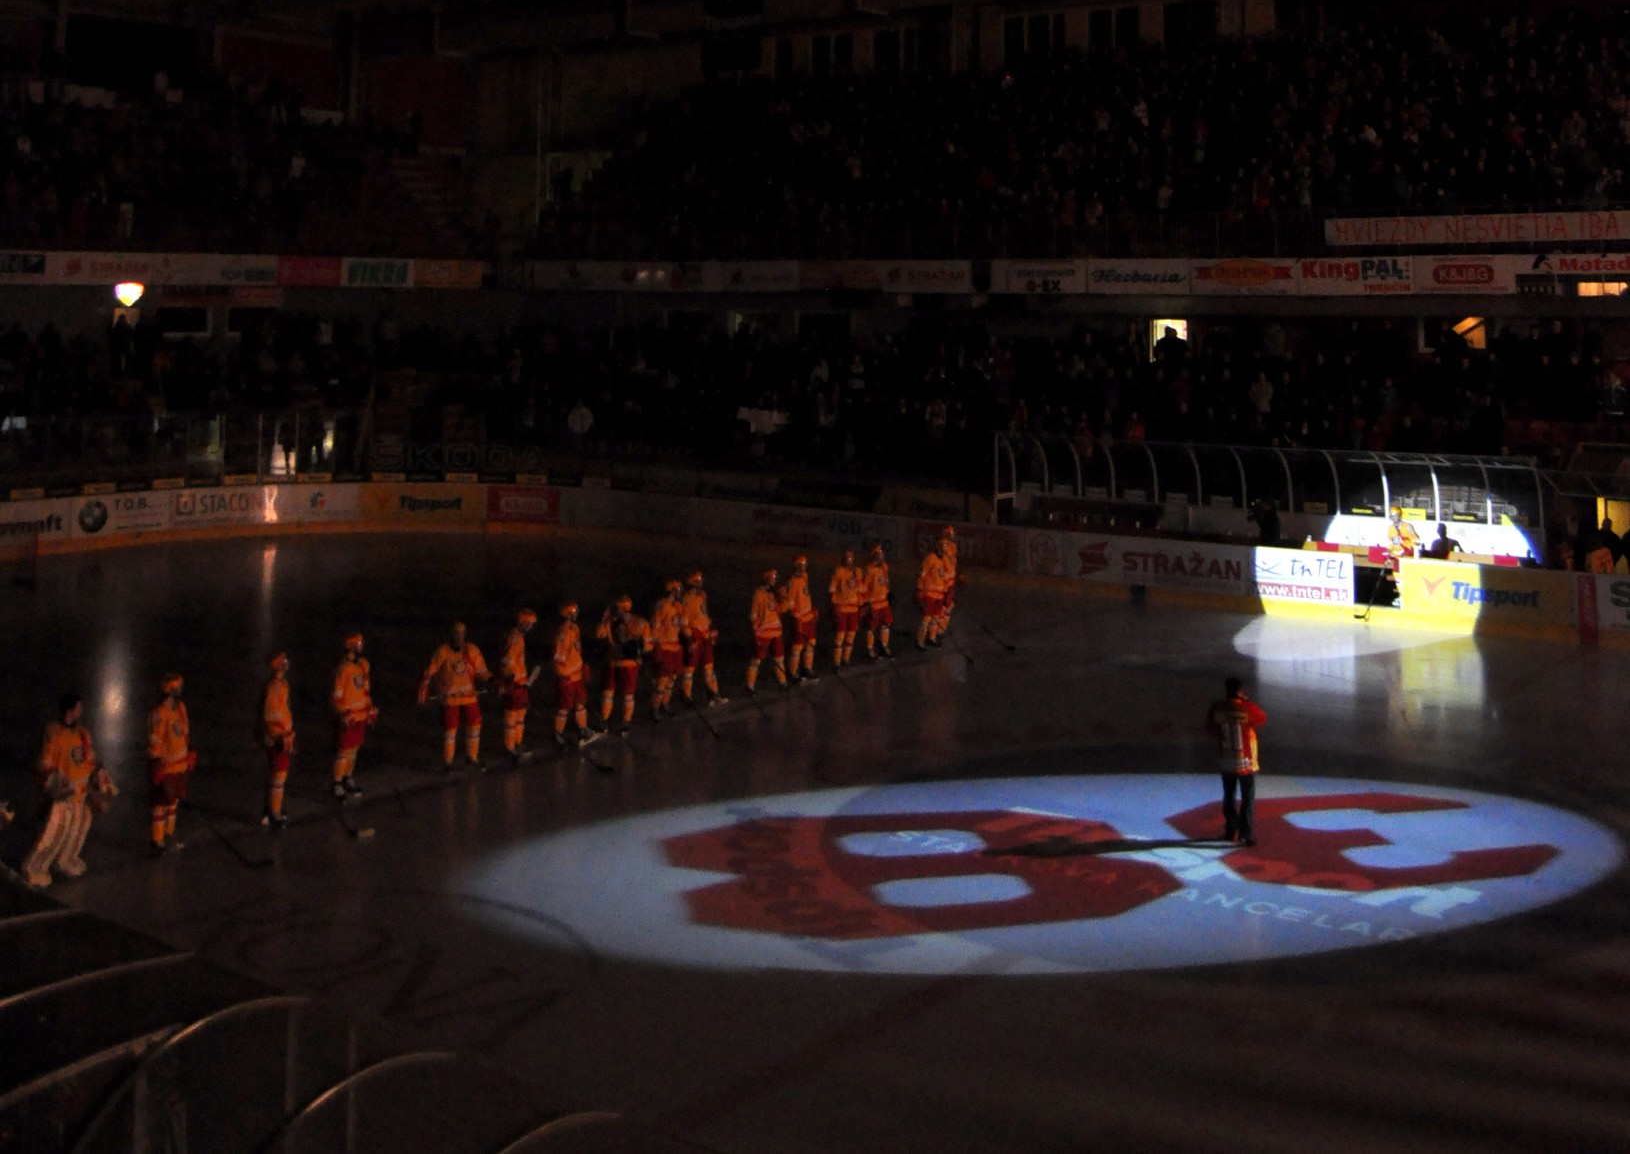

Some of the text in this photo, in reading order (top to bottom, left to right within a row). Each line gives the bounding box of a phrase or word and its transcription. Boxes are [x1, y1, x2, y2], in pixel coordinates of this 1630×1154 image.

[1335, 217, 1428, 244] HVIEZDY
[1444, 213, 1569, 243] NESVIETIA
[1121, 549, 1242, 581] STRAŽAN
[1451, 579, 1541, 609] Tipsport
